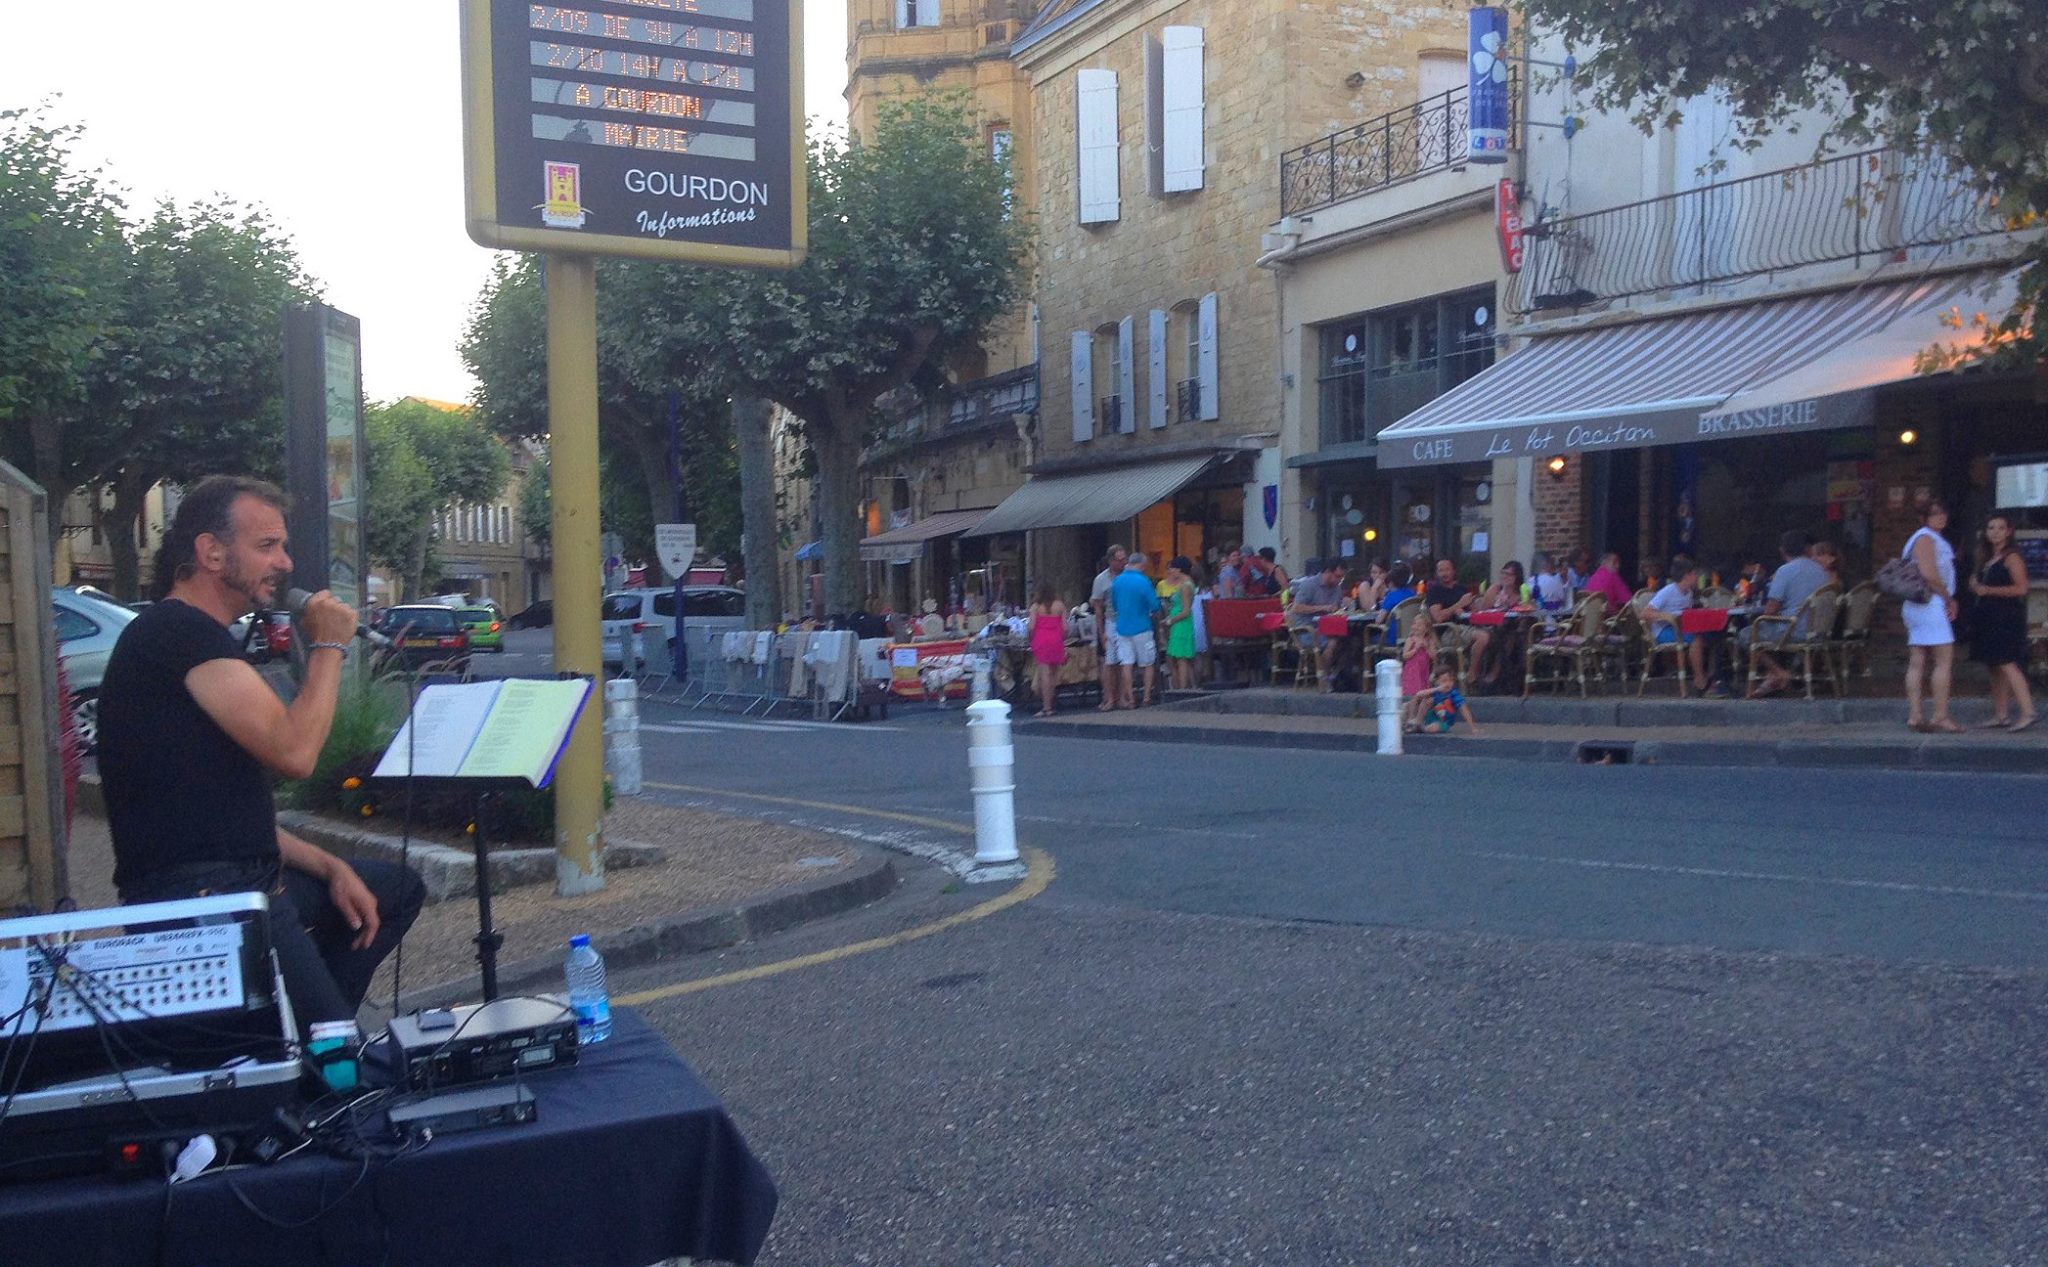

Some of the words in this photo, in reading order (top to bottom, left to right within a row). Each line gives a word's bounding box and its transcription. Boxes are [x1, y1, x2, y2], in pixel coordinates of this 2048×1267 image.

[602, 14, 630, 40] DE
[715, 30, 752, 56] 12H
[547, 43, 604, 72] 2/10
[620, 52, 660, 79] 14H
[672, 59, 687, 82] A
[575, 83, 591, 107] A
[604, 86, 701, 119] GOURDON
[605, 121, 688, 153] MAIRIE
[624, 168, 768, 206] GOURDON
[636, 206, 757, 238] Informations
[1412, 439, 1454, 461] CAFE
[1485, 433, 1514, 457] Le
[1698, 399, 1818, 434] BRASSERIE
